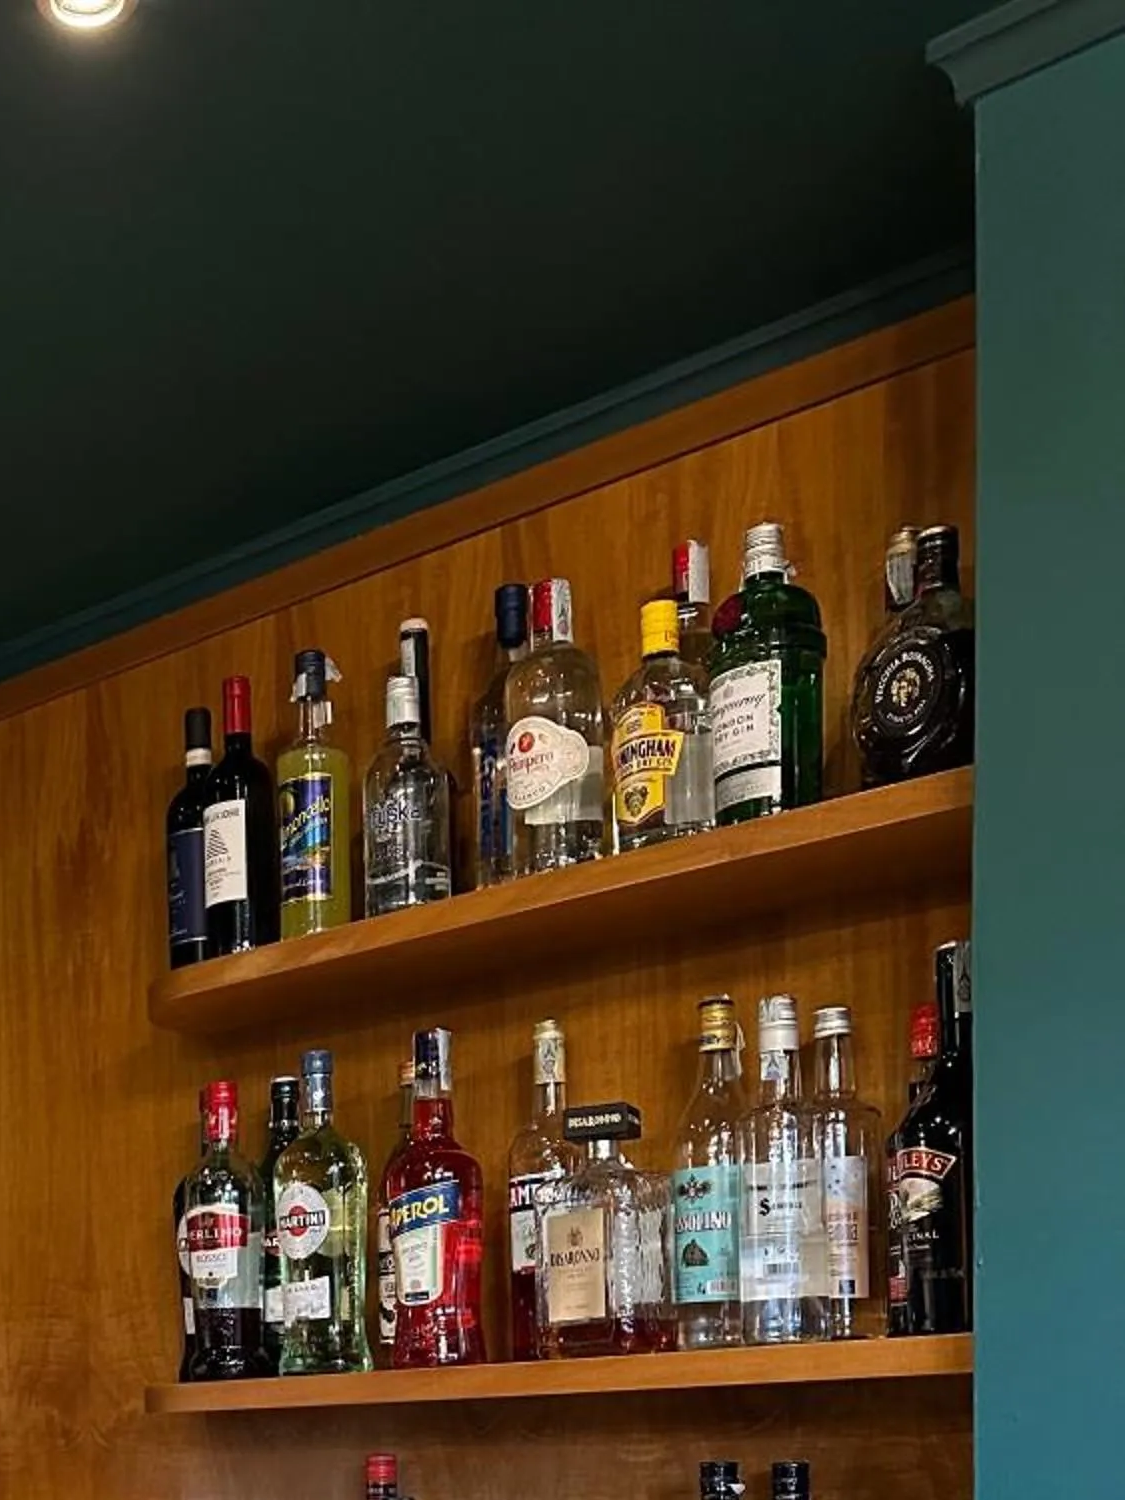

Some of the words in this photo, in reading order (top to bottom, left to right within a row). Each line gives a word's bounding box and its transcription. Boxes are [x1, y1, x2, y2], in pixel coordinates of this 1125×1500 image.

[279, 1210, 325, 1230] MARTINI
[391, 1195, 449, 1226] APEROL
[190, 1228, 242, 1241] ERLINO
